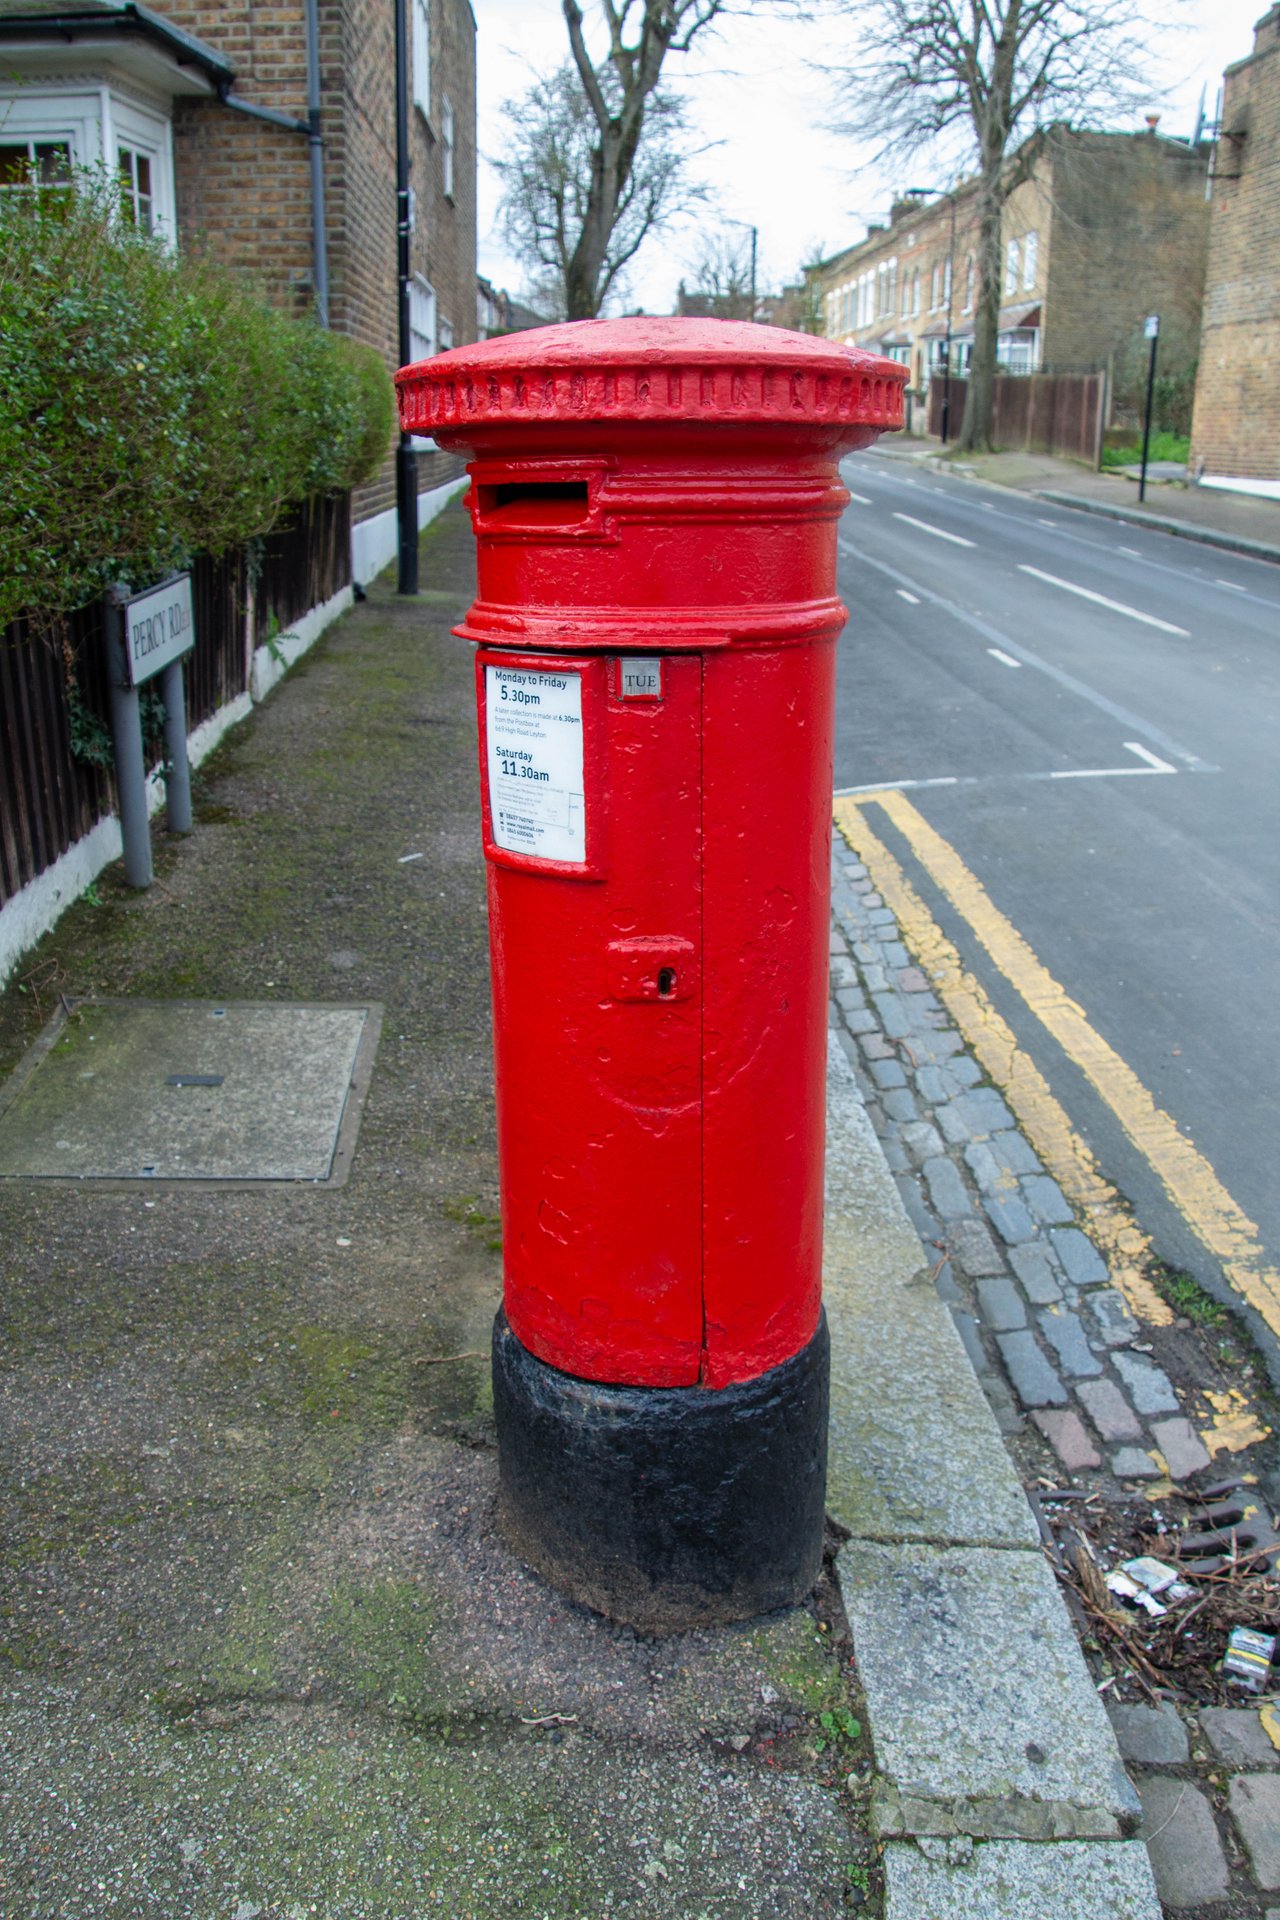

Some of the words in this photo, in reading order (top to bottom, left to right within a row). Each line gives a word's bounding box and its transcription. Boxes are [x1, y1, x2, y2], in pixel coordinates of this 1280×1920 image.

[133, 610, 166, 660] PERCY
[496, 671, 526, 686] Monday
[528, 675, 537, 685] to
[539, 676, 567, 690] Friday
[625, 675, 656, 687] TUE
[501, 685, 540, 706] 5.30pm
[510, 708, 532, 717] collection
[538, 712, 552, 720] made
[558, 714, 580, 724] 6.30pm
[505, 727, 515, 735] High
[517, 727, 529, 736] Road
[496, 746, 533, 763] Saturday
[502, 760, 549, 782] 11.30am
